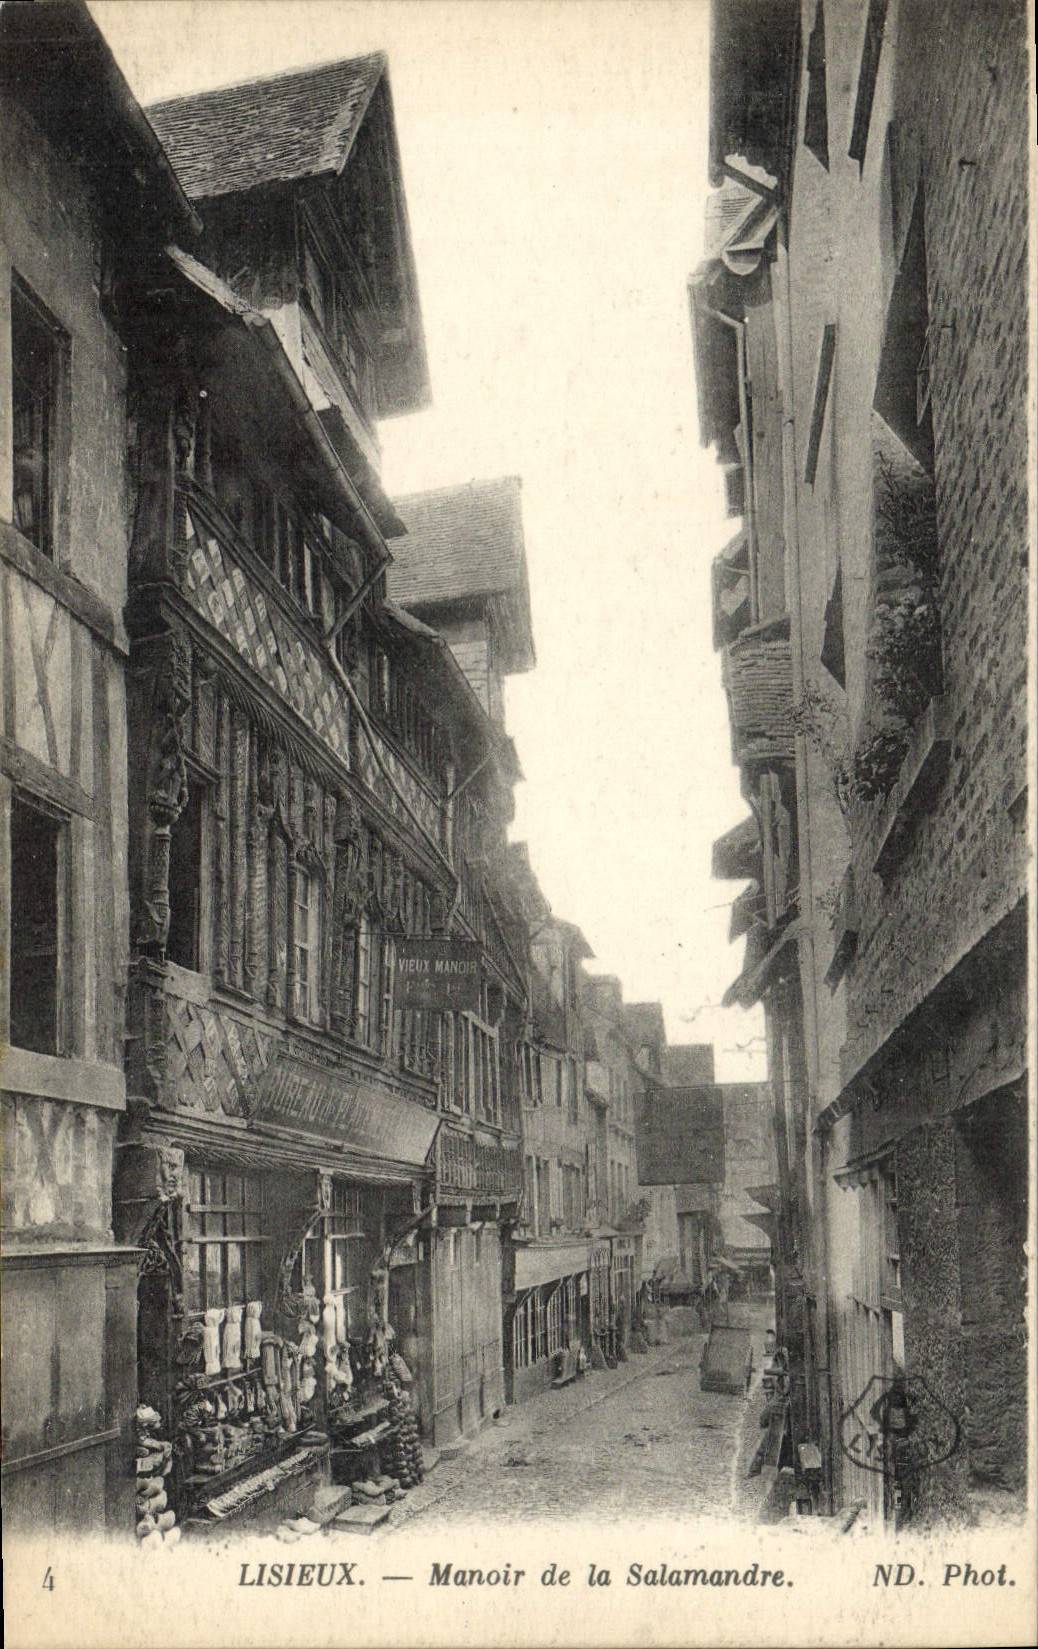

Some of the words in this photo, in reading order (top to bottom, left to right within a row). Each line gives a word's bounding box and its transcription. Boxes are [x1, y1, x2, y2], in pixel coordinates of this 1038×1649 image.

[397, 957, 431, 974] VIEUX
[434, 959, 479, 976] MANOIR
[261, 1065, 326, 1121] BUREAU
